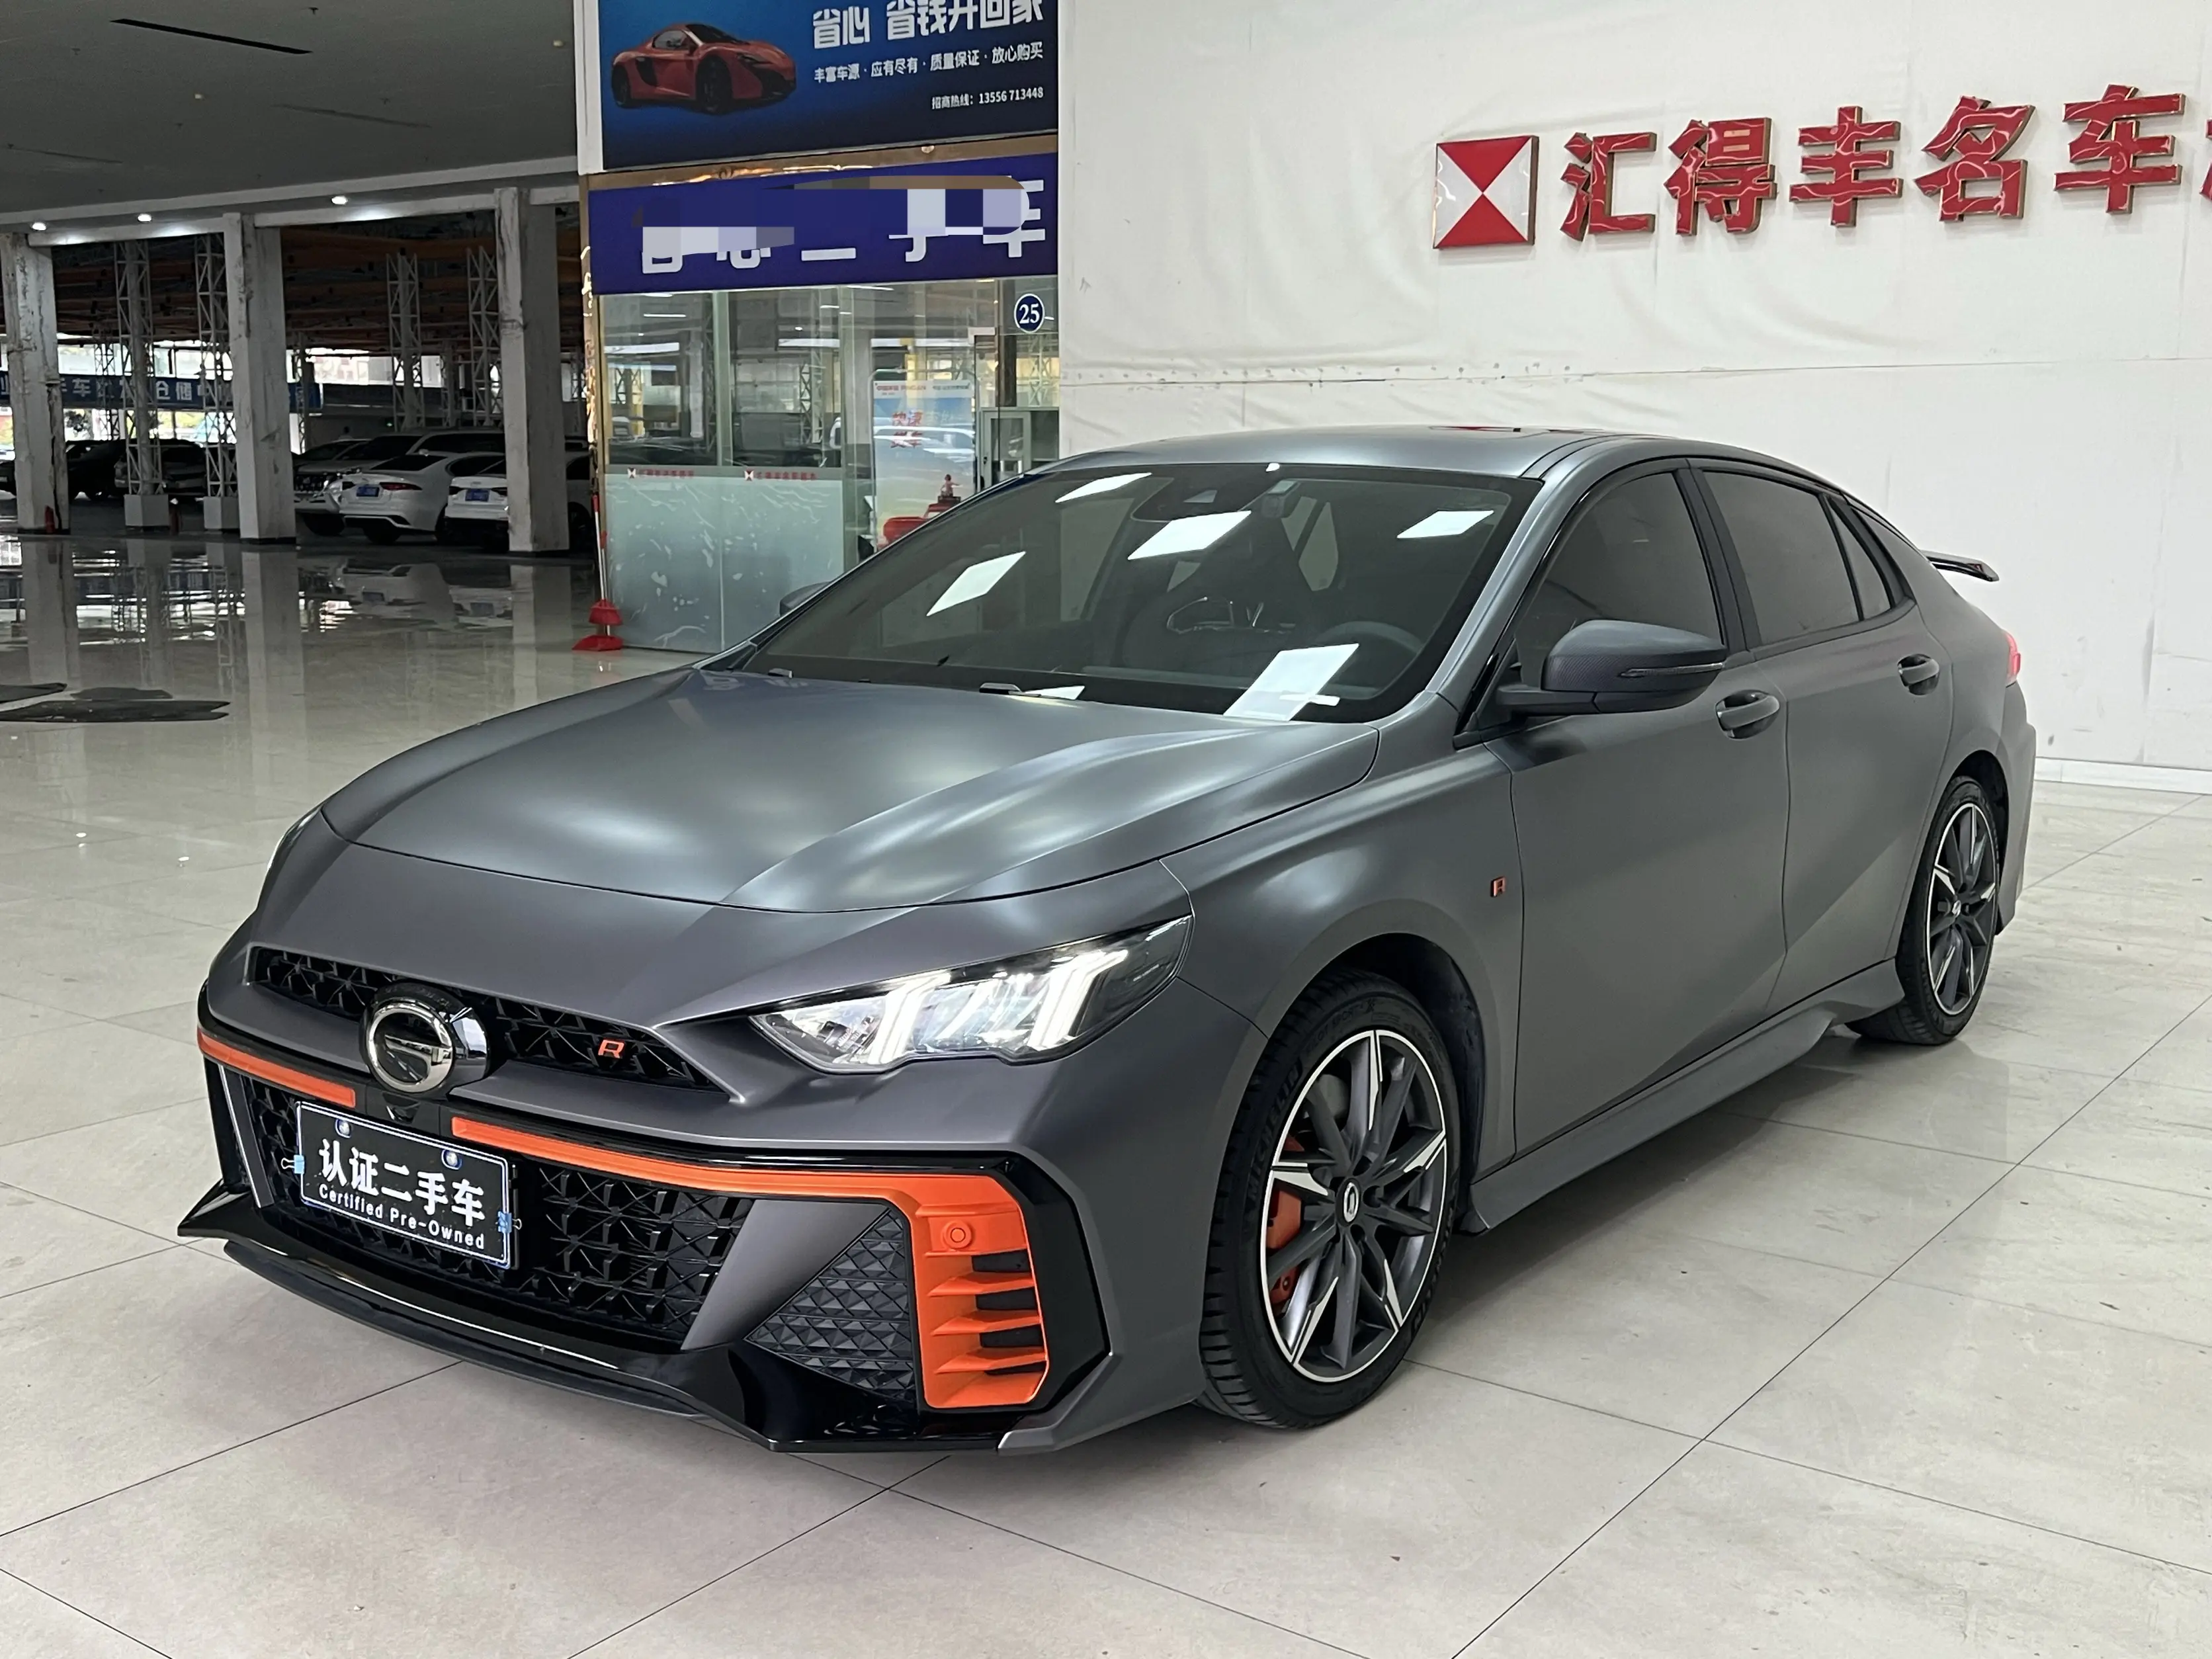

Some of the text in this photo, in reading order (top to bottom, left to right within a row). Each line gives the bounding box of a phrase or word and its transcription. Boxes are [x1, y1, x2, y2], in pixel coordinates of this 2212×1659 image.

[813, 0, 1044, 49] 省心 省钱开回家
[1559, 83, 2212, 243] 汇得丰名车
[1019, 303, 1040, 324] 25
[1490, 876, 1506, 897] R
[597, 1039, 625, 1059] R
[318, 1138, 486, 1227] 认证二手车
[319, 1183, 485, 1250] Certified Pre-Owned
